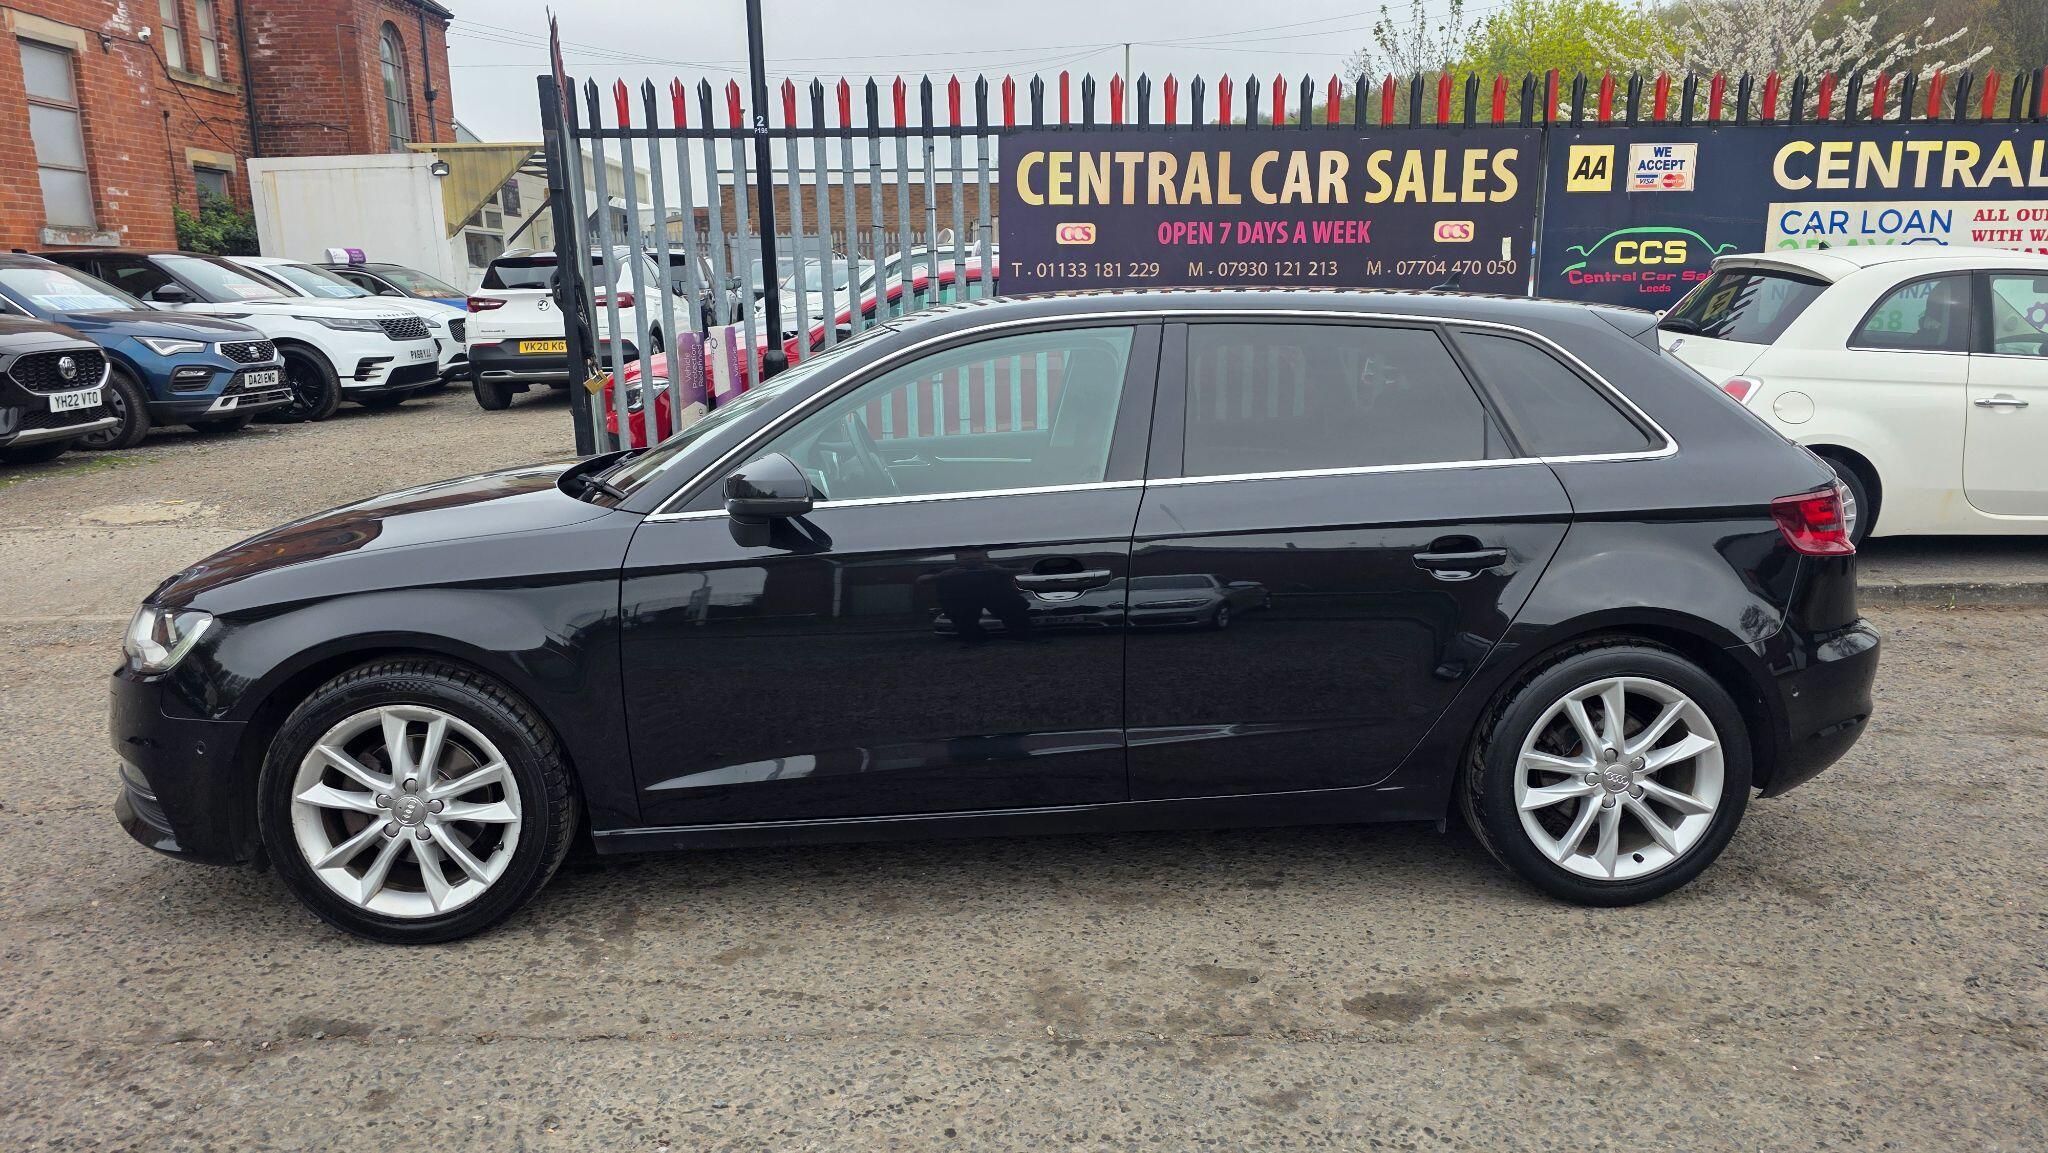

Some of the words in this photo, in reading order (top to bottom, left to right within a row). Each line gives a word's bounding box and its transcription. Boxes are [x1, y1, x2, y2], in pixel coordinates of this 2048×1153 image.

[757, 115, 765, 126] 2
[1653, 146, 1673, 158] WE
[1573, 155, 1607, 180] AA
[1638, 159, 1686, 171] ACCEPT
[1773, 140, 2048, 191] CENTRAL
[1016, 151, 1242, 206] CENTRAL
[1250, 150, 1350, 205] CAR
[1364, 148, 1519, 203] SALES
[1779, 209, 1849, 235] CAR
[1860, 209, 1953, 234] LOAN
[1973, 208, 2010, 222] ALL
[1157, 221, 1213, 245] OPEN
[1219, 221, 1232, 245] 7
[1237, 221, 1289, 244] DAYS
[1293, 221, 1308, 244] A
[1313, 220, 1372, 244] WEEK
[1971, 229, 2024, 242] WITH
[2030, 229, 2048, 242] W
[1614, 240, 1687, 265] CCS
[1036, 262, 1087, 278] 01133
[1095, 262, 1121, 278] 181
[1127, 262, 1160, 278] 229
[1218, 261, 1268, 277] 07930
[1274, 261, 1301, 276] 121
[1308, 261, 1338, 276] 213
[1396, 260, 1447, 276] 07704
[1451, 260, 1482, 276] 470
[1486, 260, 1517, 276] 050
[1568, 269, 1637, 285] Central
[1641, 271, 1677, 281] Car
[1681, 269, 1713, 281] Sal
[1639, 283, 1672, 293] Leeds
[523, 342, 549, 351] VK20
[551, 342, 565, 351] KG
[54, 393, 80, 409] YH22
